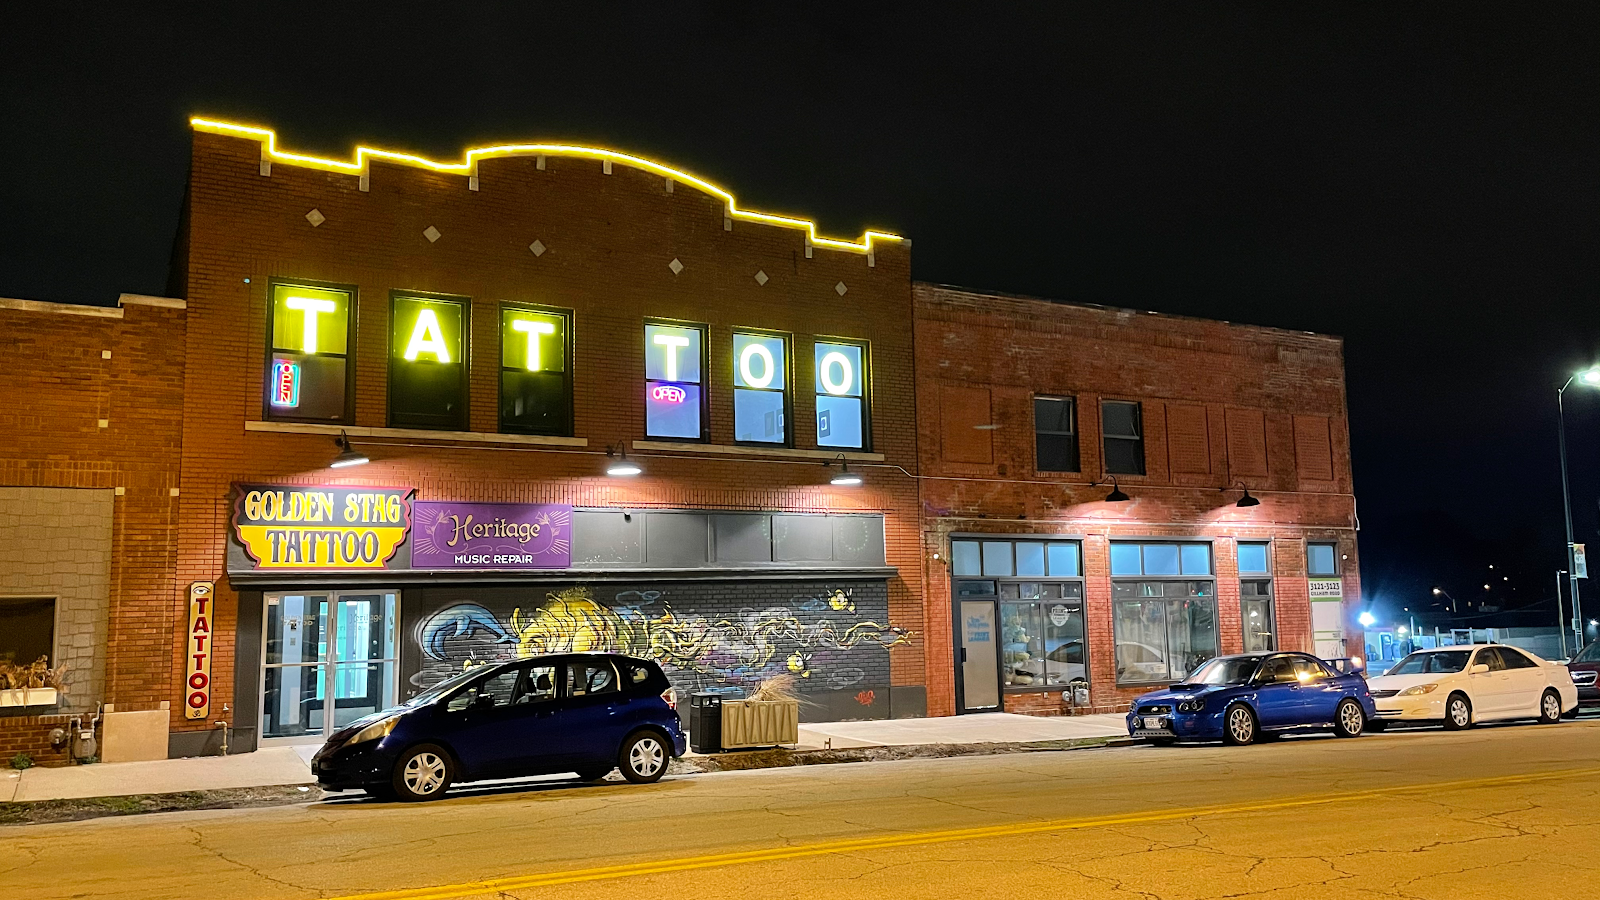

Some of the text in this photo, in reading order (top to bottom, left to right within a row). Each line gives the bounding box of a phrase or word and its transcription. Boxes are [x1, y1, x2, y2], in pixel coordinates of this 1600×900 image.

[281, 363, 292, 404] OPEN
[653, 386, 684, 403] OPEN
[244, 490, 401, 523] GOLDEN STAG
[265, 529, 380, 564] TATTOO
[446, 514, 541, 547] Heritage
[454, 554, 533, 564] MUSIC REPAIR
[1310, 582, 1340, 591] 3121-3123
[187, 597, 210, 709] TATTOO
